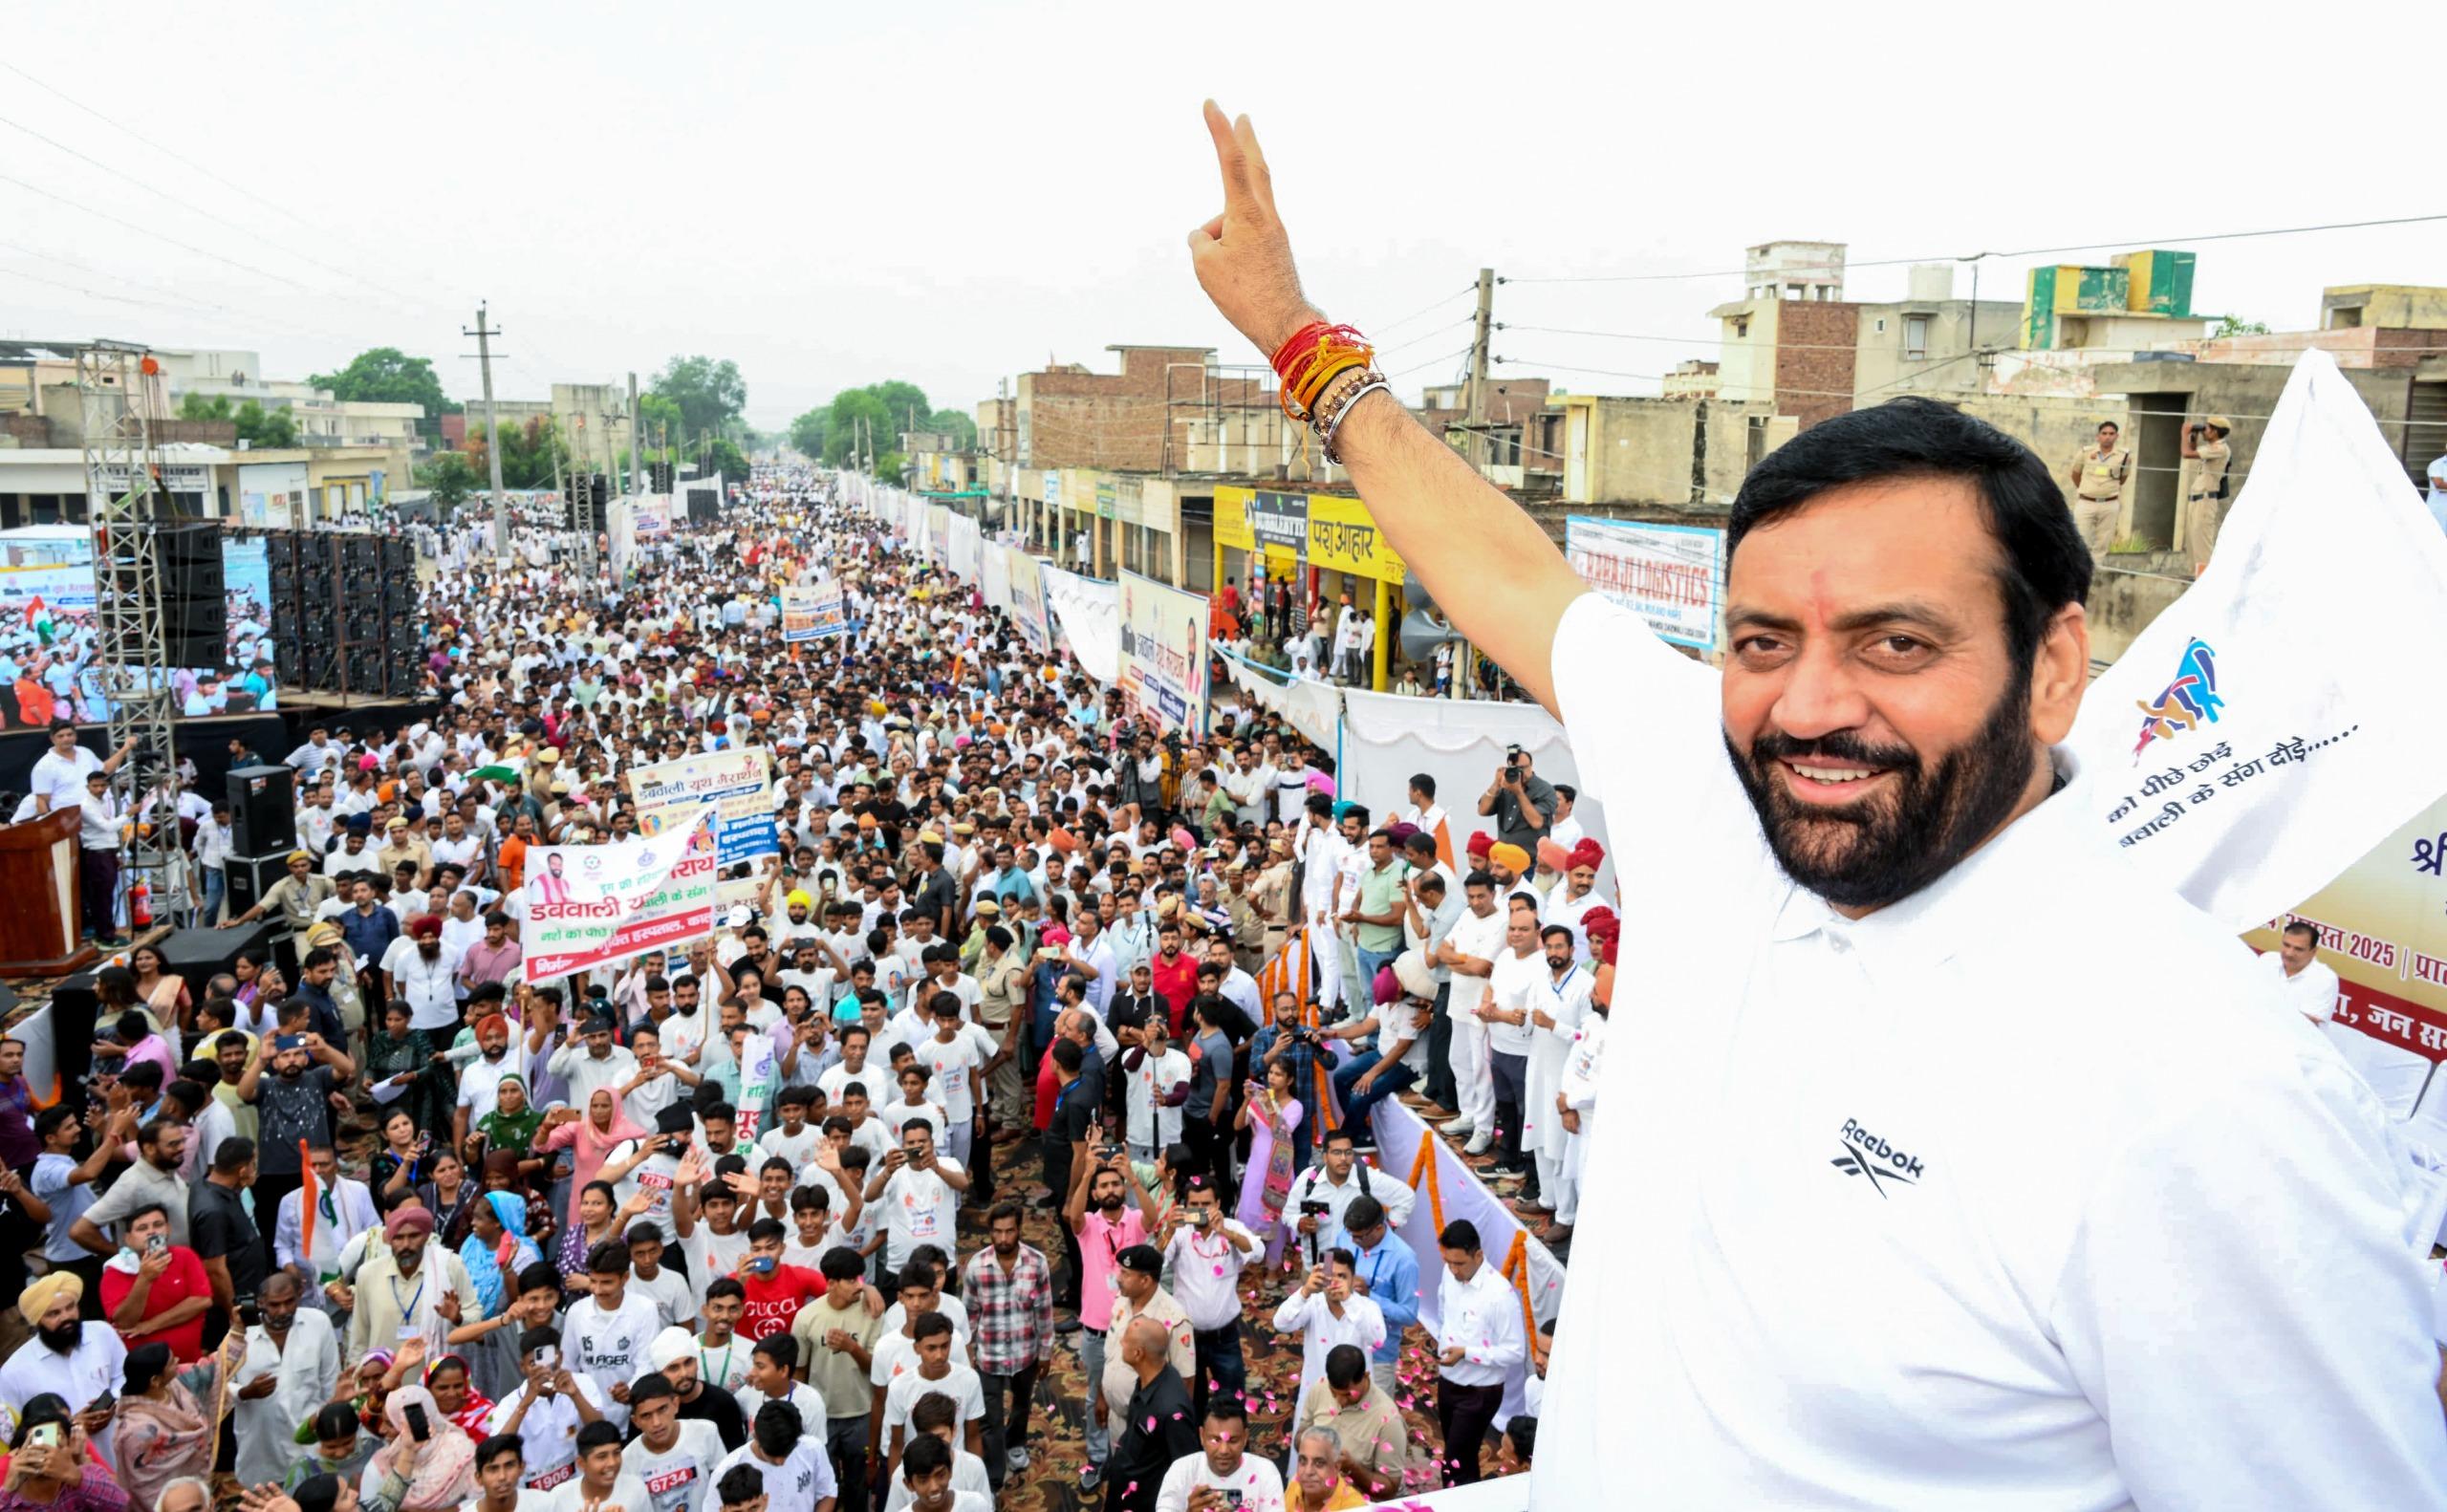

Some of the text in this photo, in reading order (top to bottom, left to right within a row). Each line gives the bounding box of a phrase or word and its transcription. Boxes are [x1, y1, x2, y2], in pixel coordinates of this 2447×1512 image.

[1335, 521, 1375, 563] आहार
[2139, 767, 2185, 798] पीछे
[2187, 784, 2215, 805] के
[2218, 763, 2265, 788] संग
[2350, 933, 2395, 968] 2025
[2367, 1003, 2415, 1040] जन
[1840, 1117, 1924, 1179] Reebok
[535, 1465, 570, 1490] 1906
[650, 1469, 688, 1494] 6734
